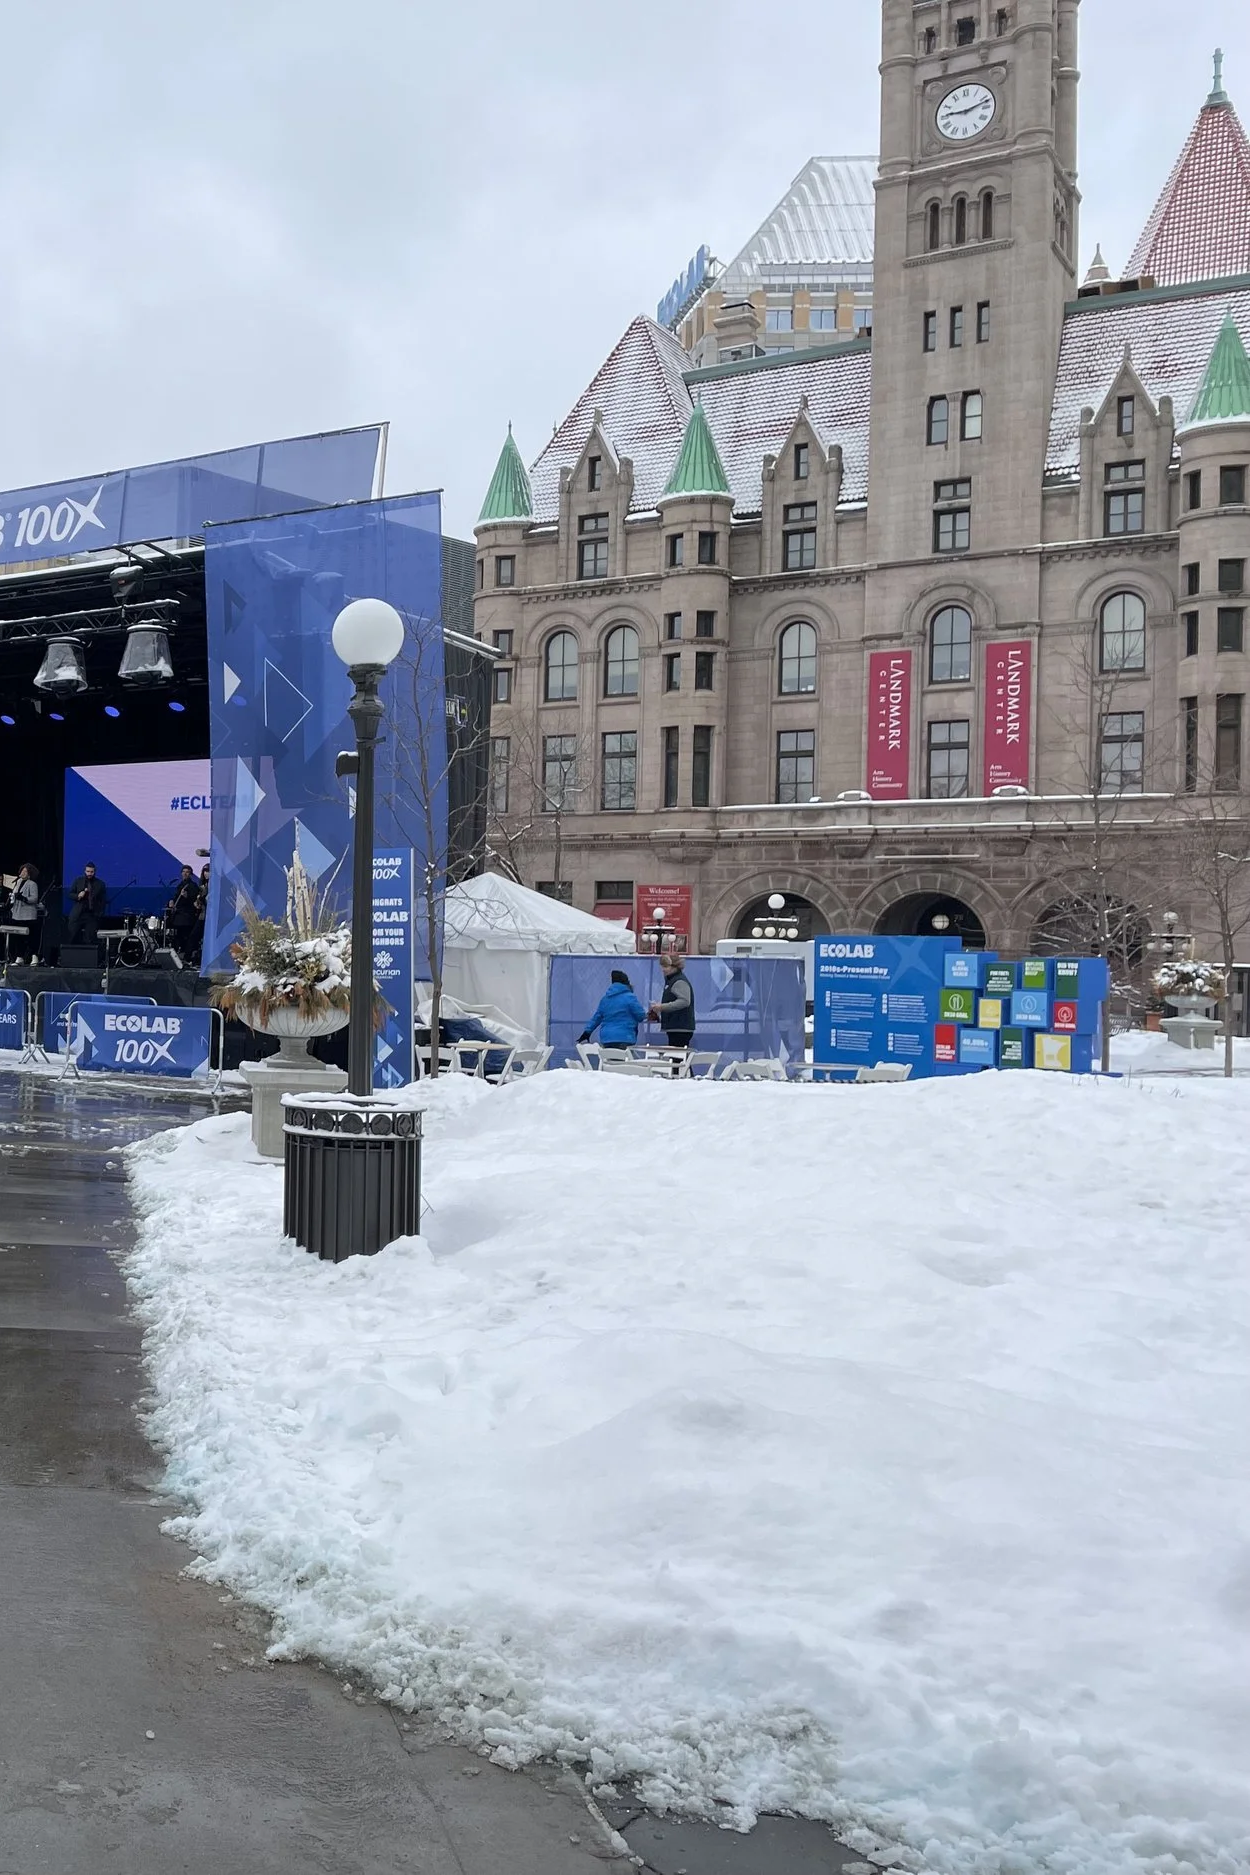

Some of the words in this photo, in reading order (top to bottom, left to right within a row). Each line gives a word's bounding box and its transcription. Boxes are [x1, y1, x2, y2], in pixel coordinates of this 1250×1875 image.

[14, 484, 106, 548] 100X
[888, 659, 905, 751] LANDMARK
[996, 661, 1004, 735] CENTER
[1006, 650, 1024, 745] LANDMARK
[878, 670, 887, 741] CENTER
[372, 857, 402, 866] COLAB
[648, 887, 680, 895] Welcome!
[372, 911, 409, 922] OLAB
[372, 928, 384, 936] OM
[384, 928, 404, 936] YOUR
[372, 937, 405, 946] IGHBORS
[819, 943, 875, 958] ECOLAB
[873, 966, 889, 976] Day
[114, 1035, 177, 1067] 100X
